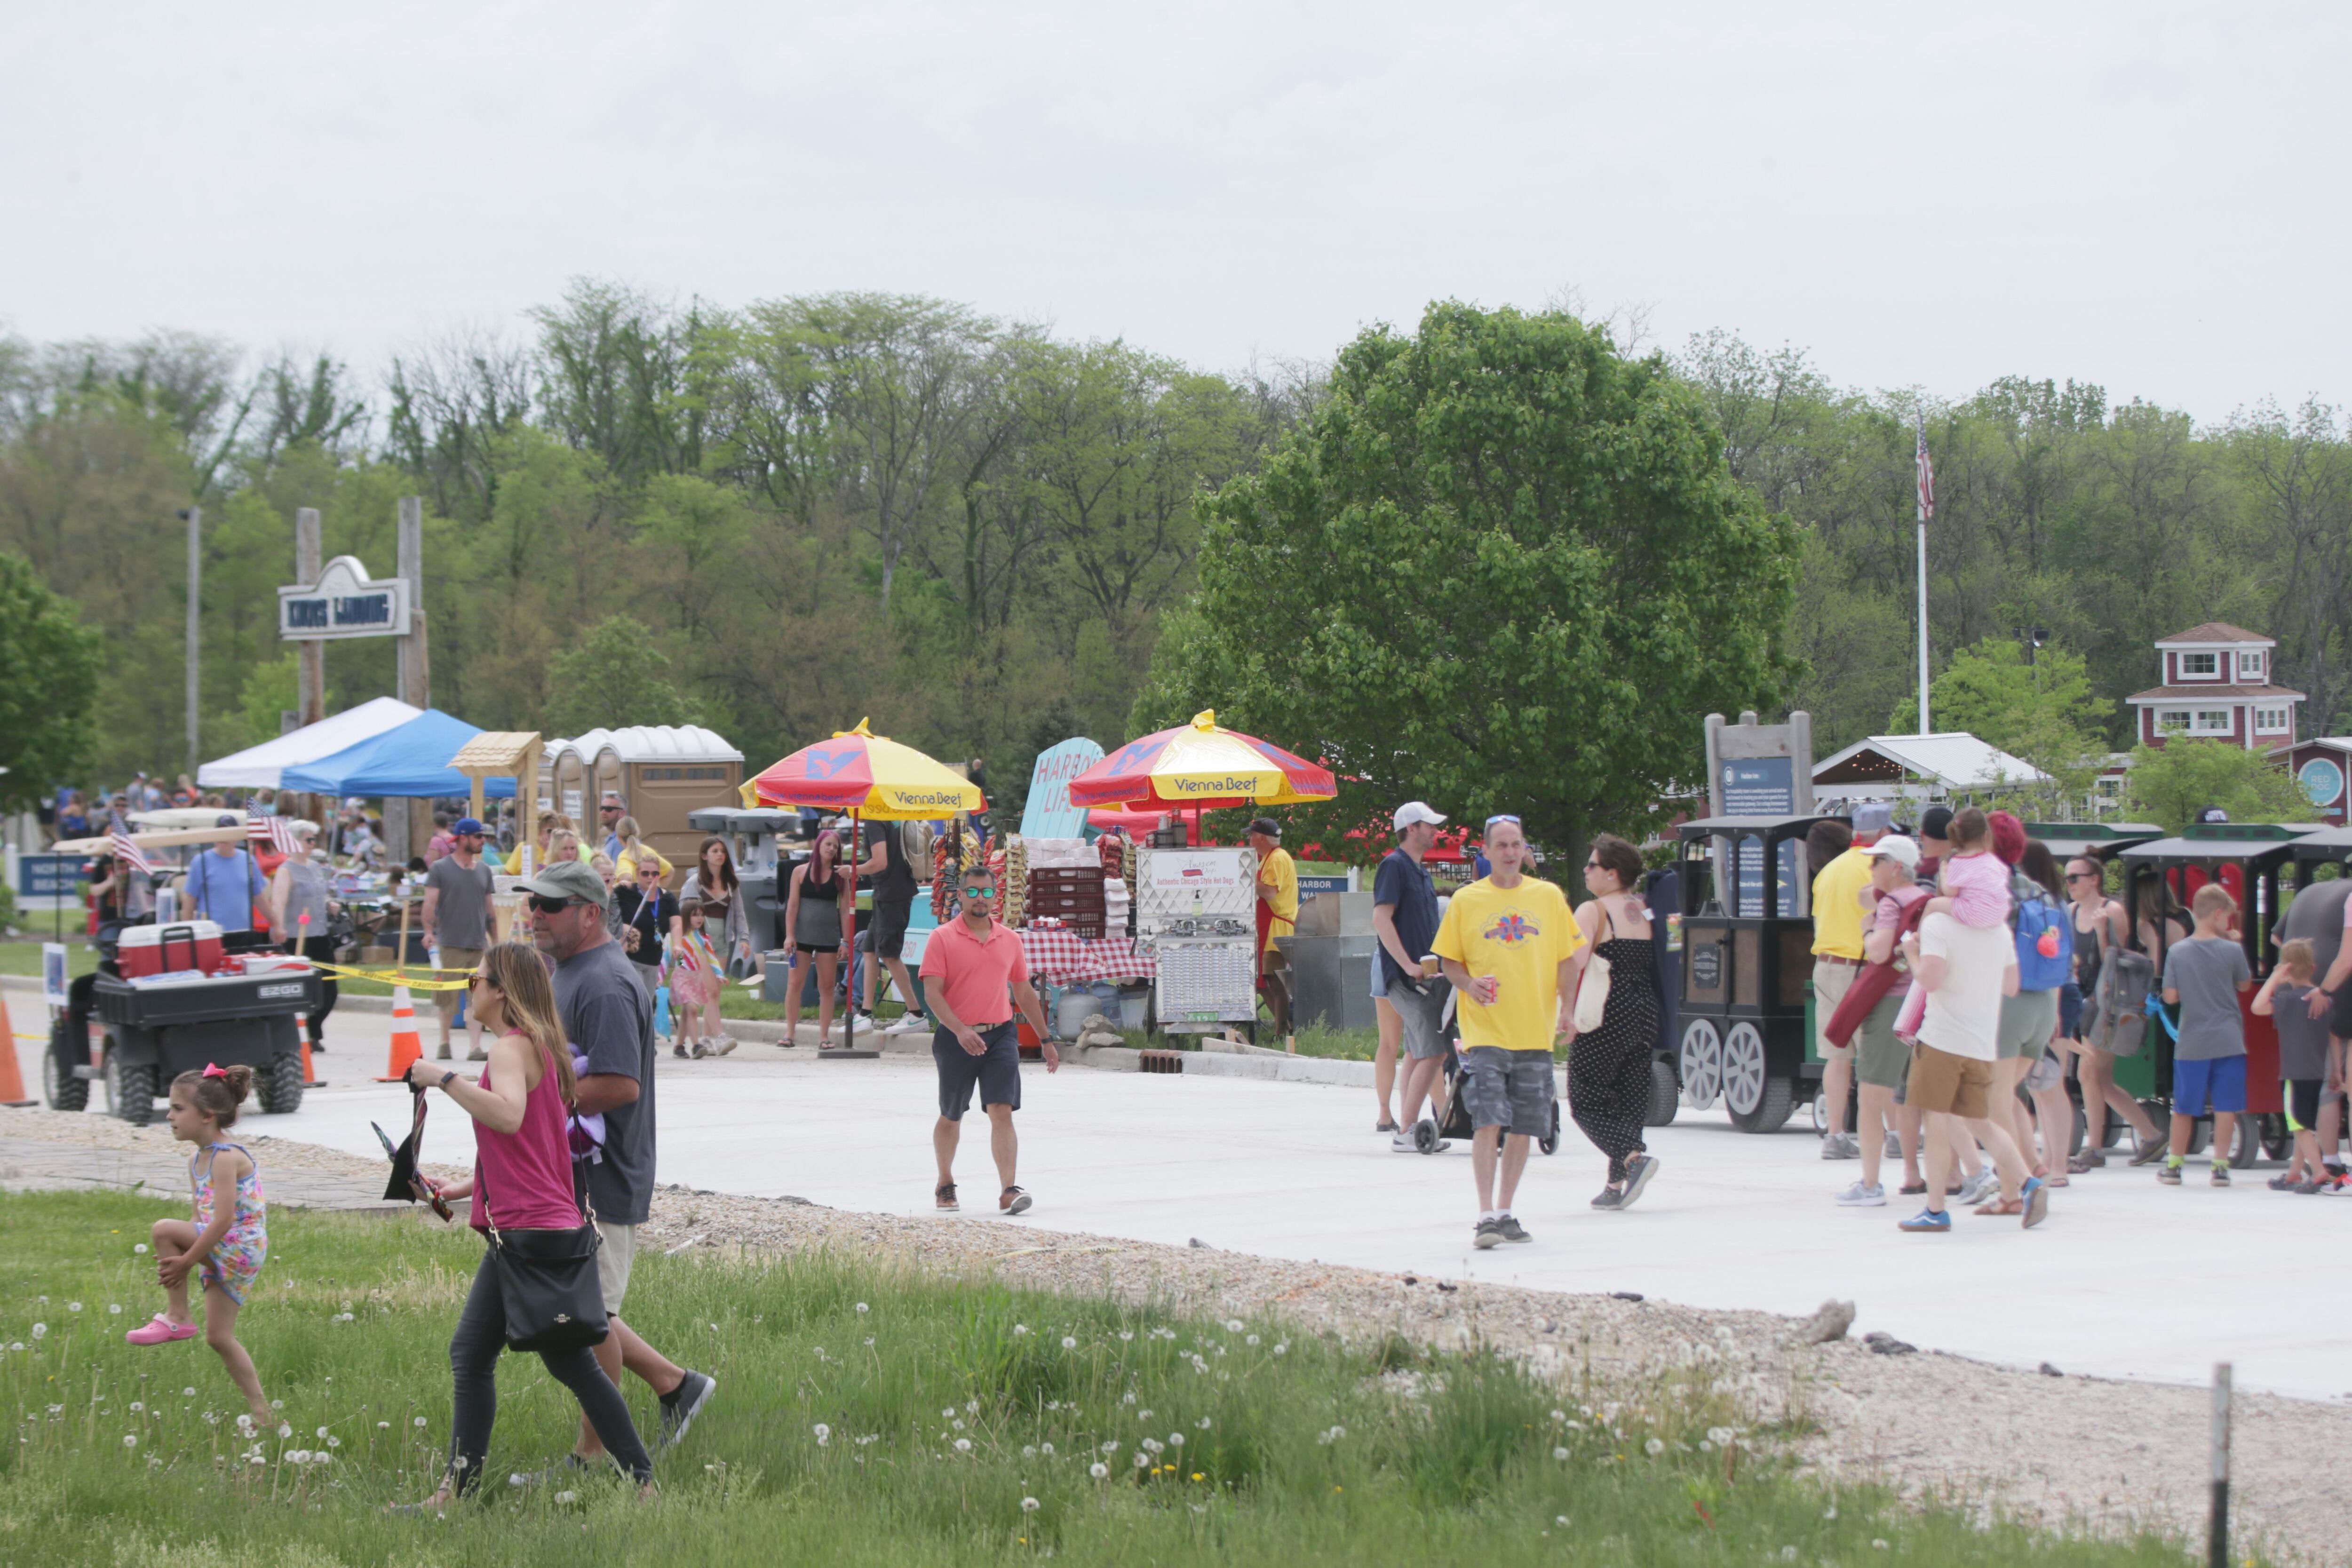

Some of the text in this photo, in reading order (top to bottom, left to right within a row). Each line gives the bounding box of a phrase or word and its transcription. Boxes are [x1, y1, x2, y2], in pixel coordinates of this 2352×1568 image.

[1036, 753, 1097, 784] HARBO
[1175, 777, 1257, 793] Vienna Beef
[895, 792, 961, 808] Vienna Beef
[1200, 877, 1212, 886] Style
[260, 985, 301, 996] EZGO
[412, 981, 444, 989] CAUTION
